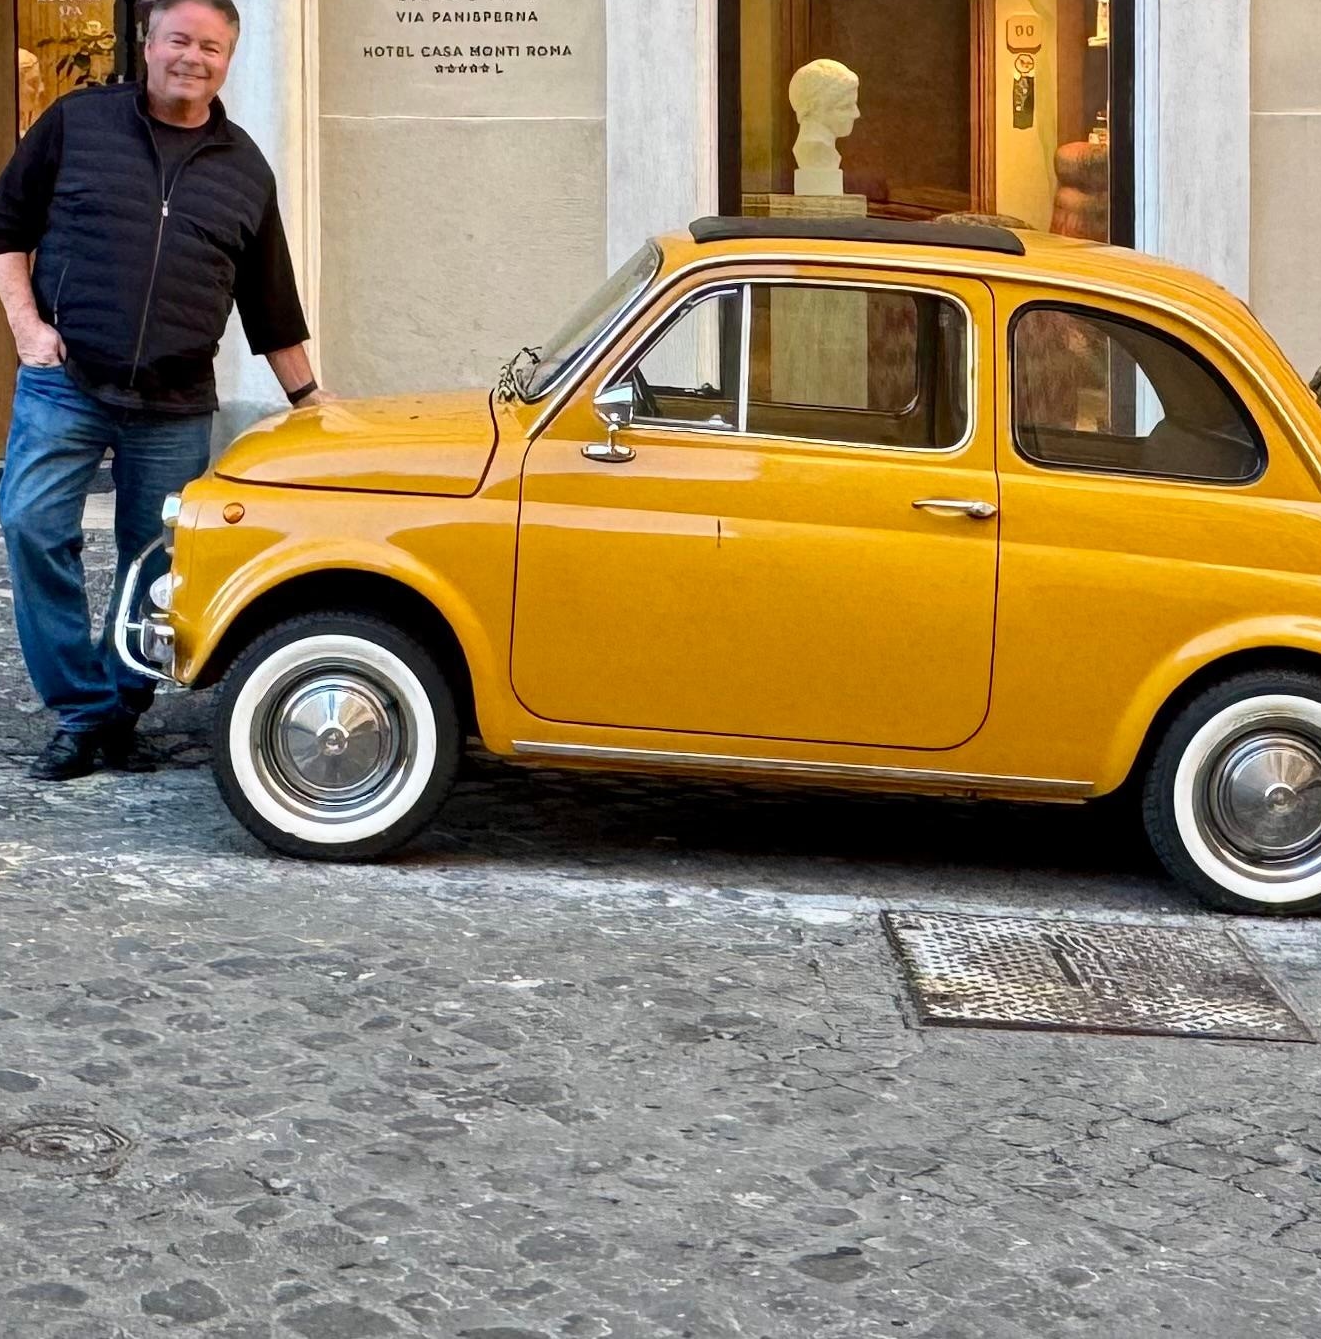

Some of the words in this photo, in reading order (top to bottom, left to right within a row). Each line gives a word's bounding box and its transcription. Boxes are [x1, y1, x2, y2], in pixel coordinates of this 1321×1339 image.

[395, 11, 425, 23] VIA
[432, 10, 539, 23] PANISPERNA
[363, 45, 415, 58] HOTEL
[421, 45, 463, 58] CASA
[469, 45, 520, 57] MONTI
[526, 44, 573, 57] ROMA
